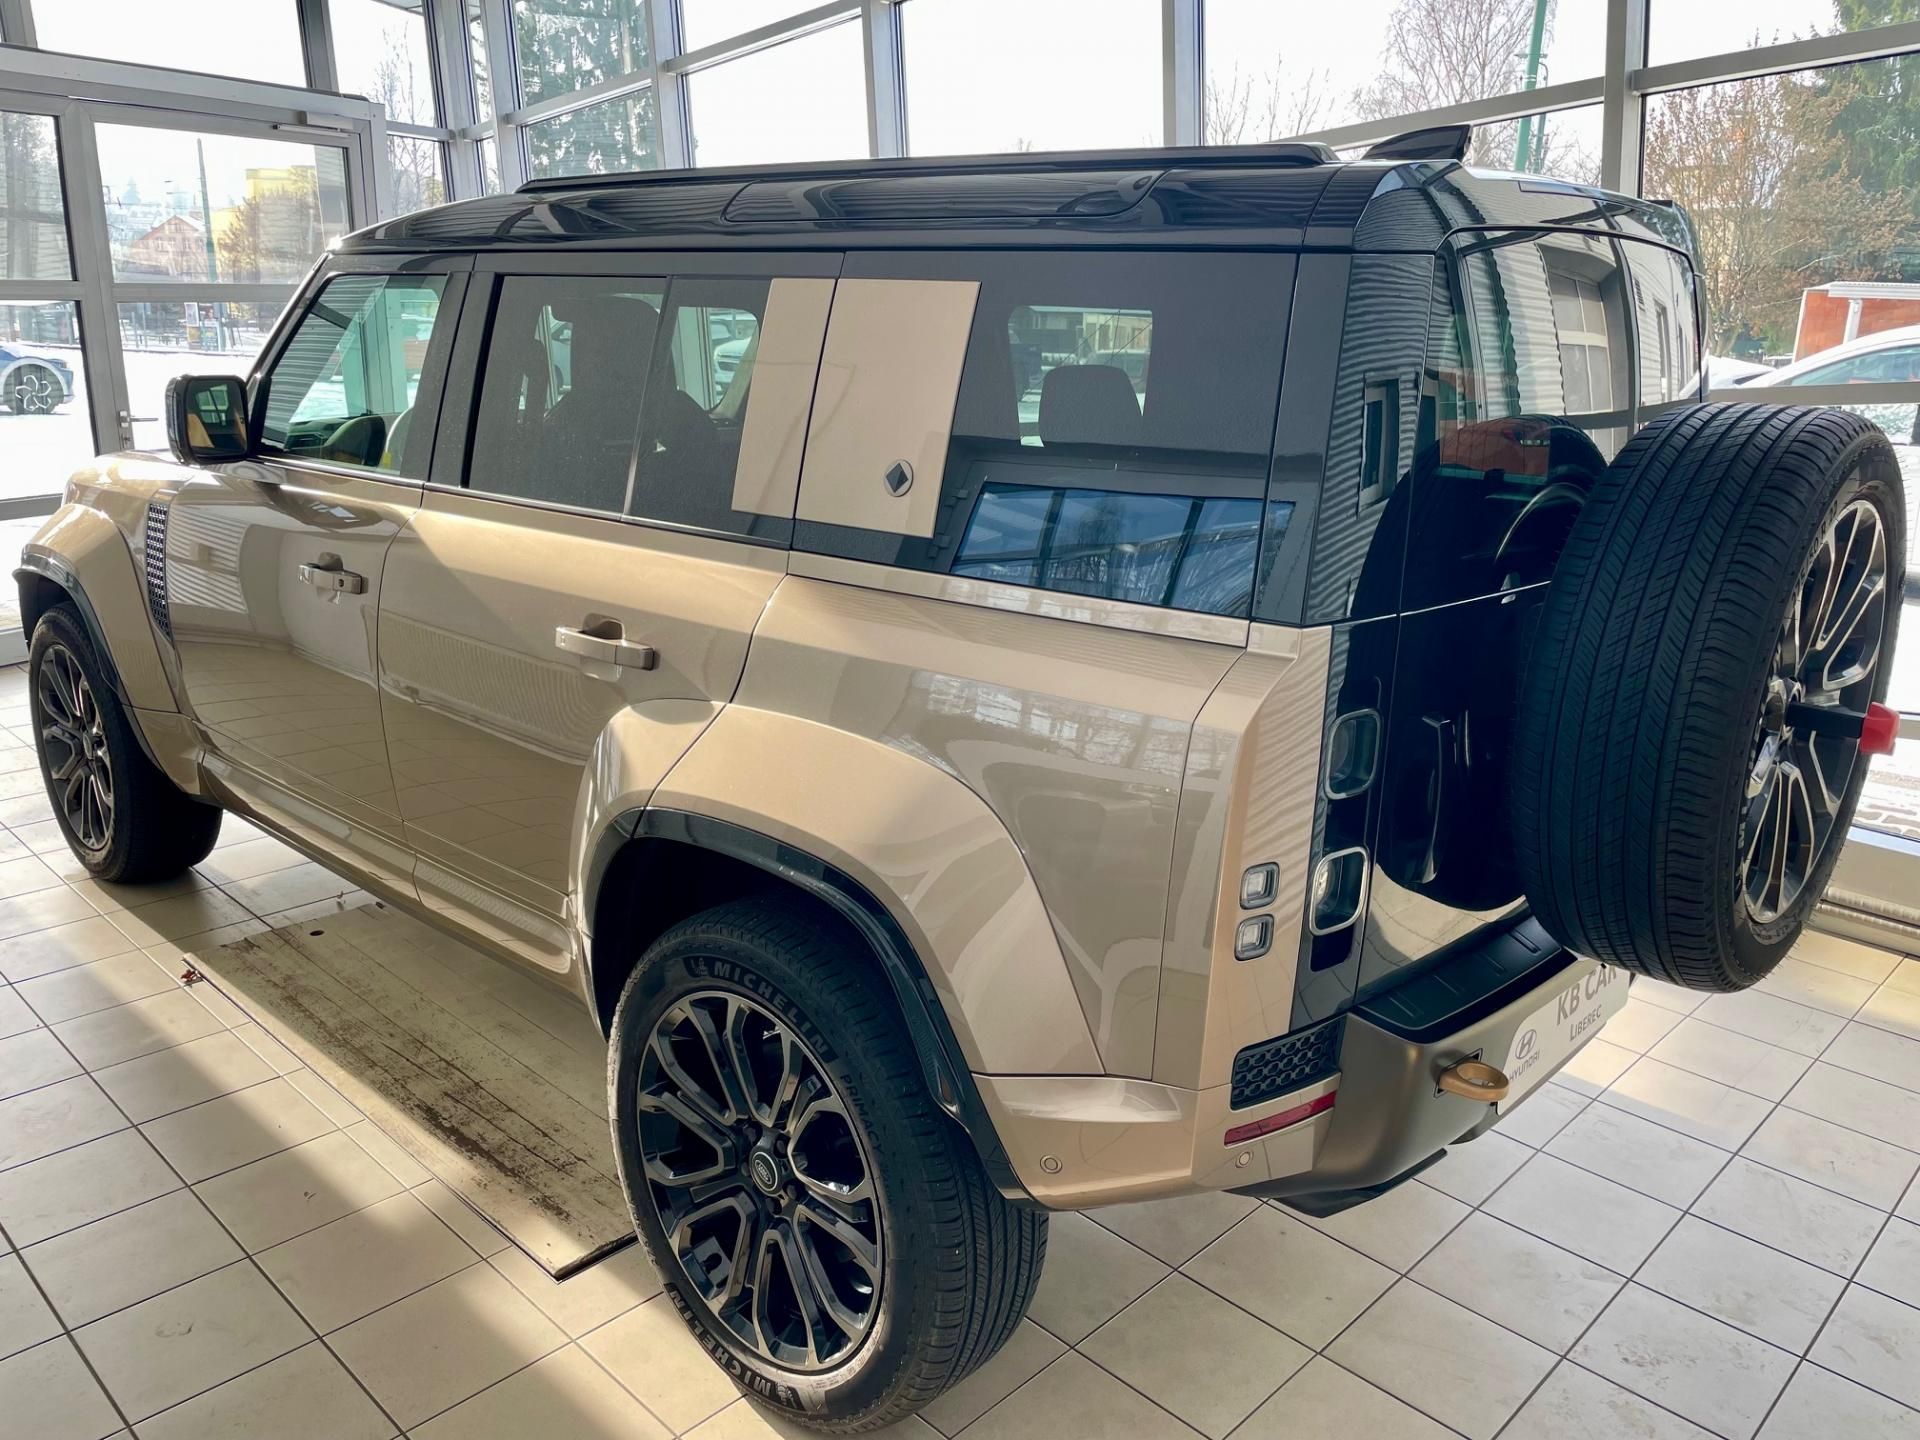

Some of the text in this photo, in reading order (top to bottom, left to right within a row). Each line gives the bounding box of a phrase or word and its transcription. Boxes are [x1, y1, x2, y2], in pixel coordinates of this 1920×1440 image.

[713, 960, 830, 1055] MICHELIN
[1556, 982, 1581, 1026] KB
[1569, 1004, 1602, 1042] LIBEREC
[1509, 1048, 1541, 1082] HYUNDAI
[839, 1072, 885, 1157] PRIMACY
[669, 1289, 772, 1397] MICHELIN
